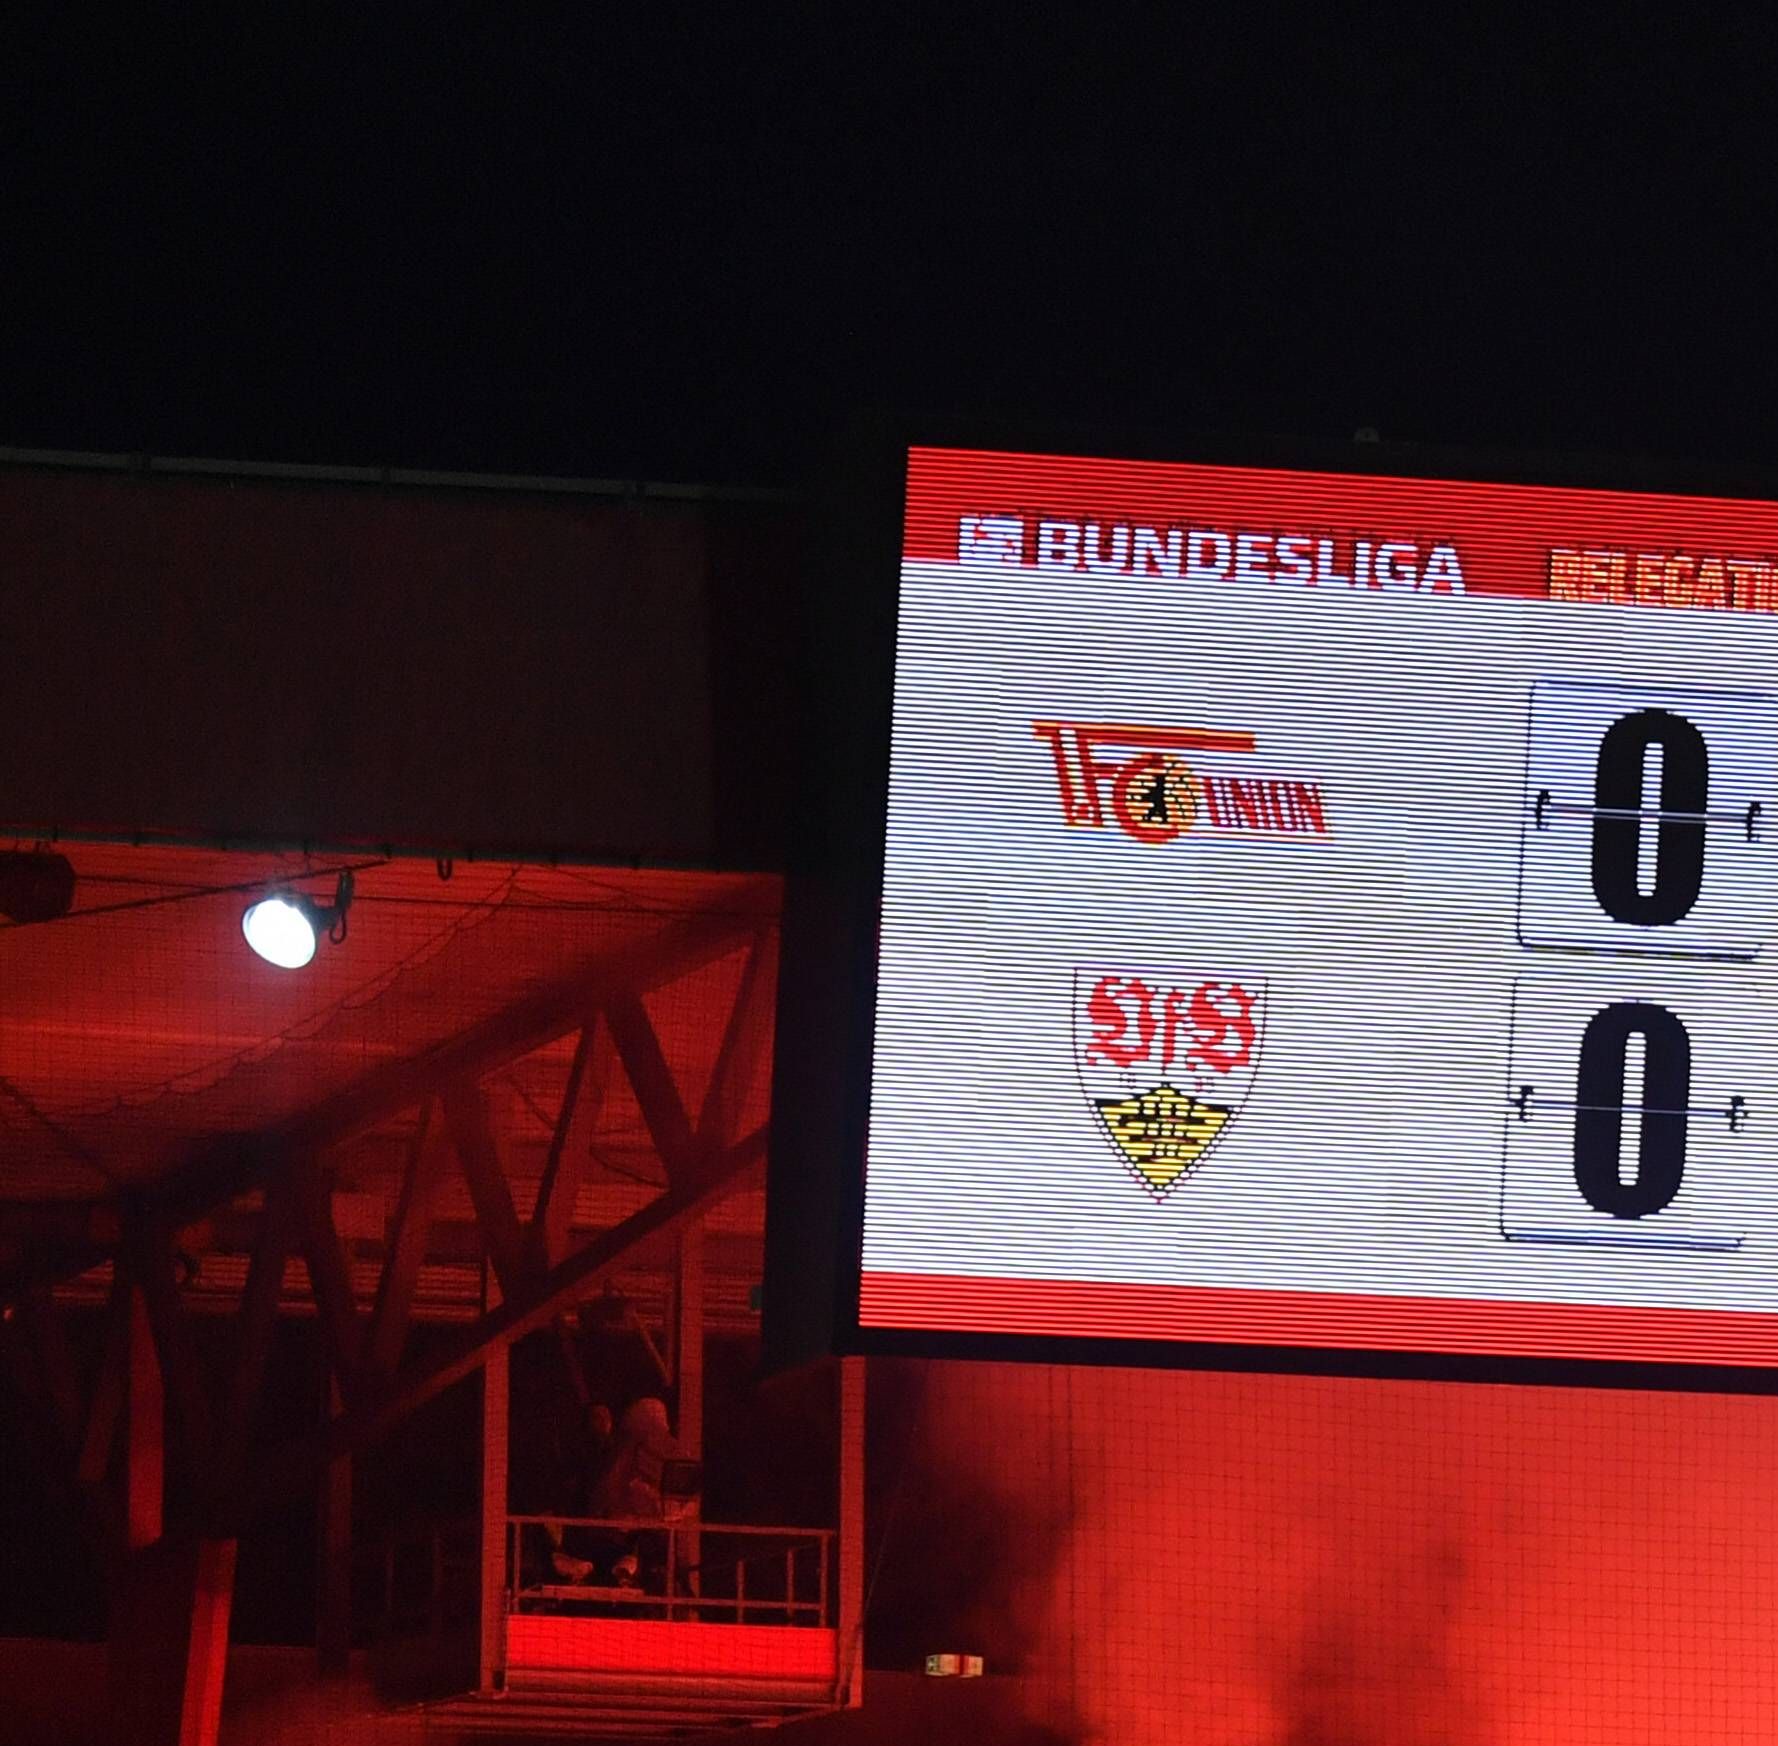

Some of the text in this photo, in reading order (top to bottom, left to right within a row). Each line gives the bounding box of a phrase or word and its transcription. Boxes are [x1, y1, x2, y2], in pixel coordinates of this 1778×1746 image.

[1036, 520, 1466, 596] BUNDESLIGA
[1204, 777, 1328, 834] UNION
[1591, 708, 1708, 927] 0
[1573, 1001, 1691, 1220] 0
